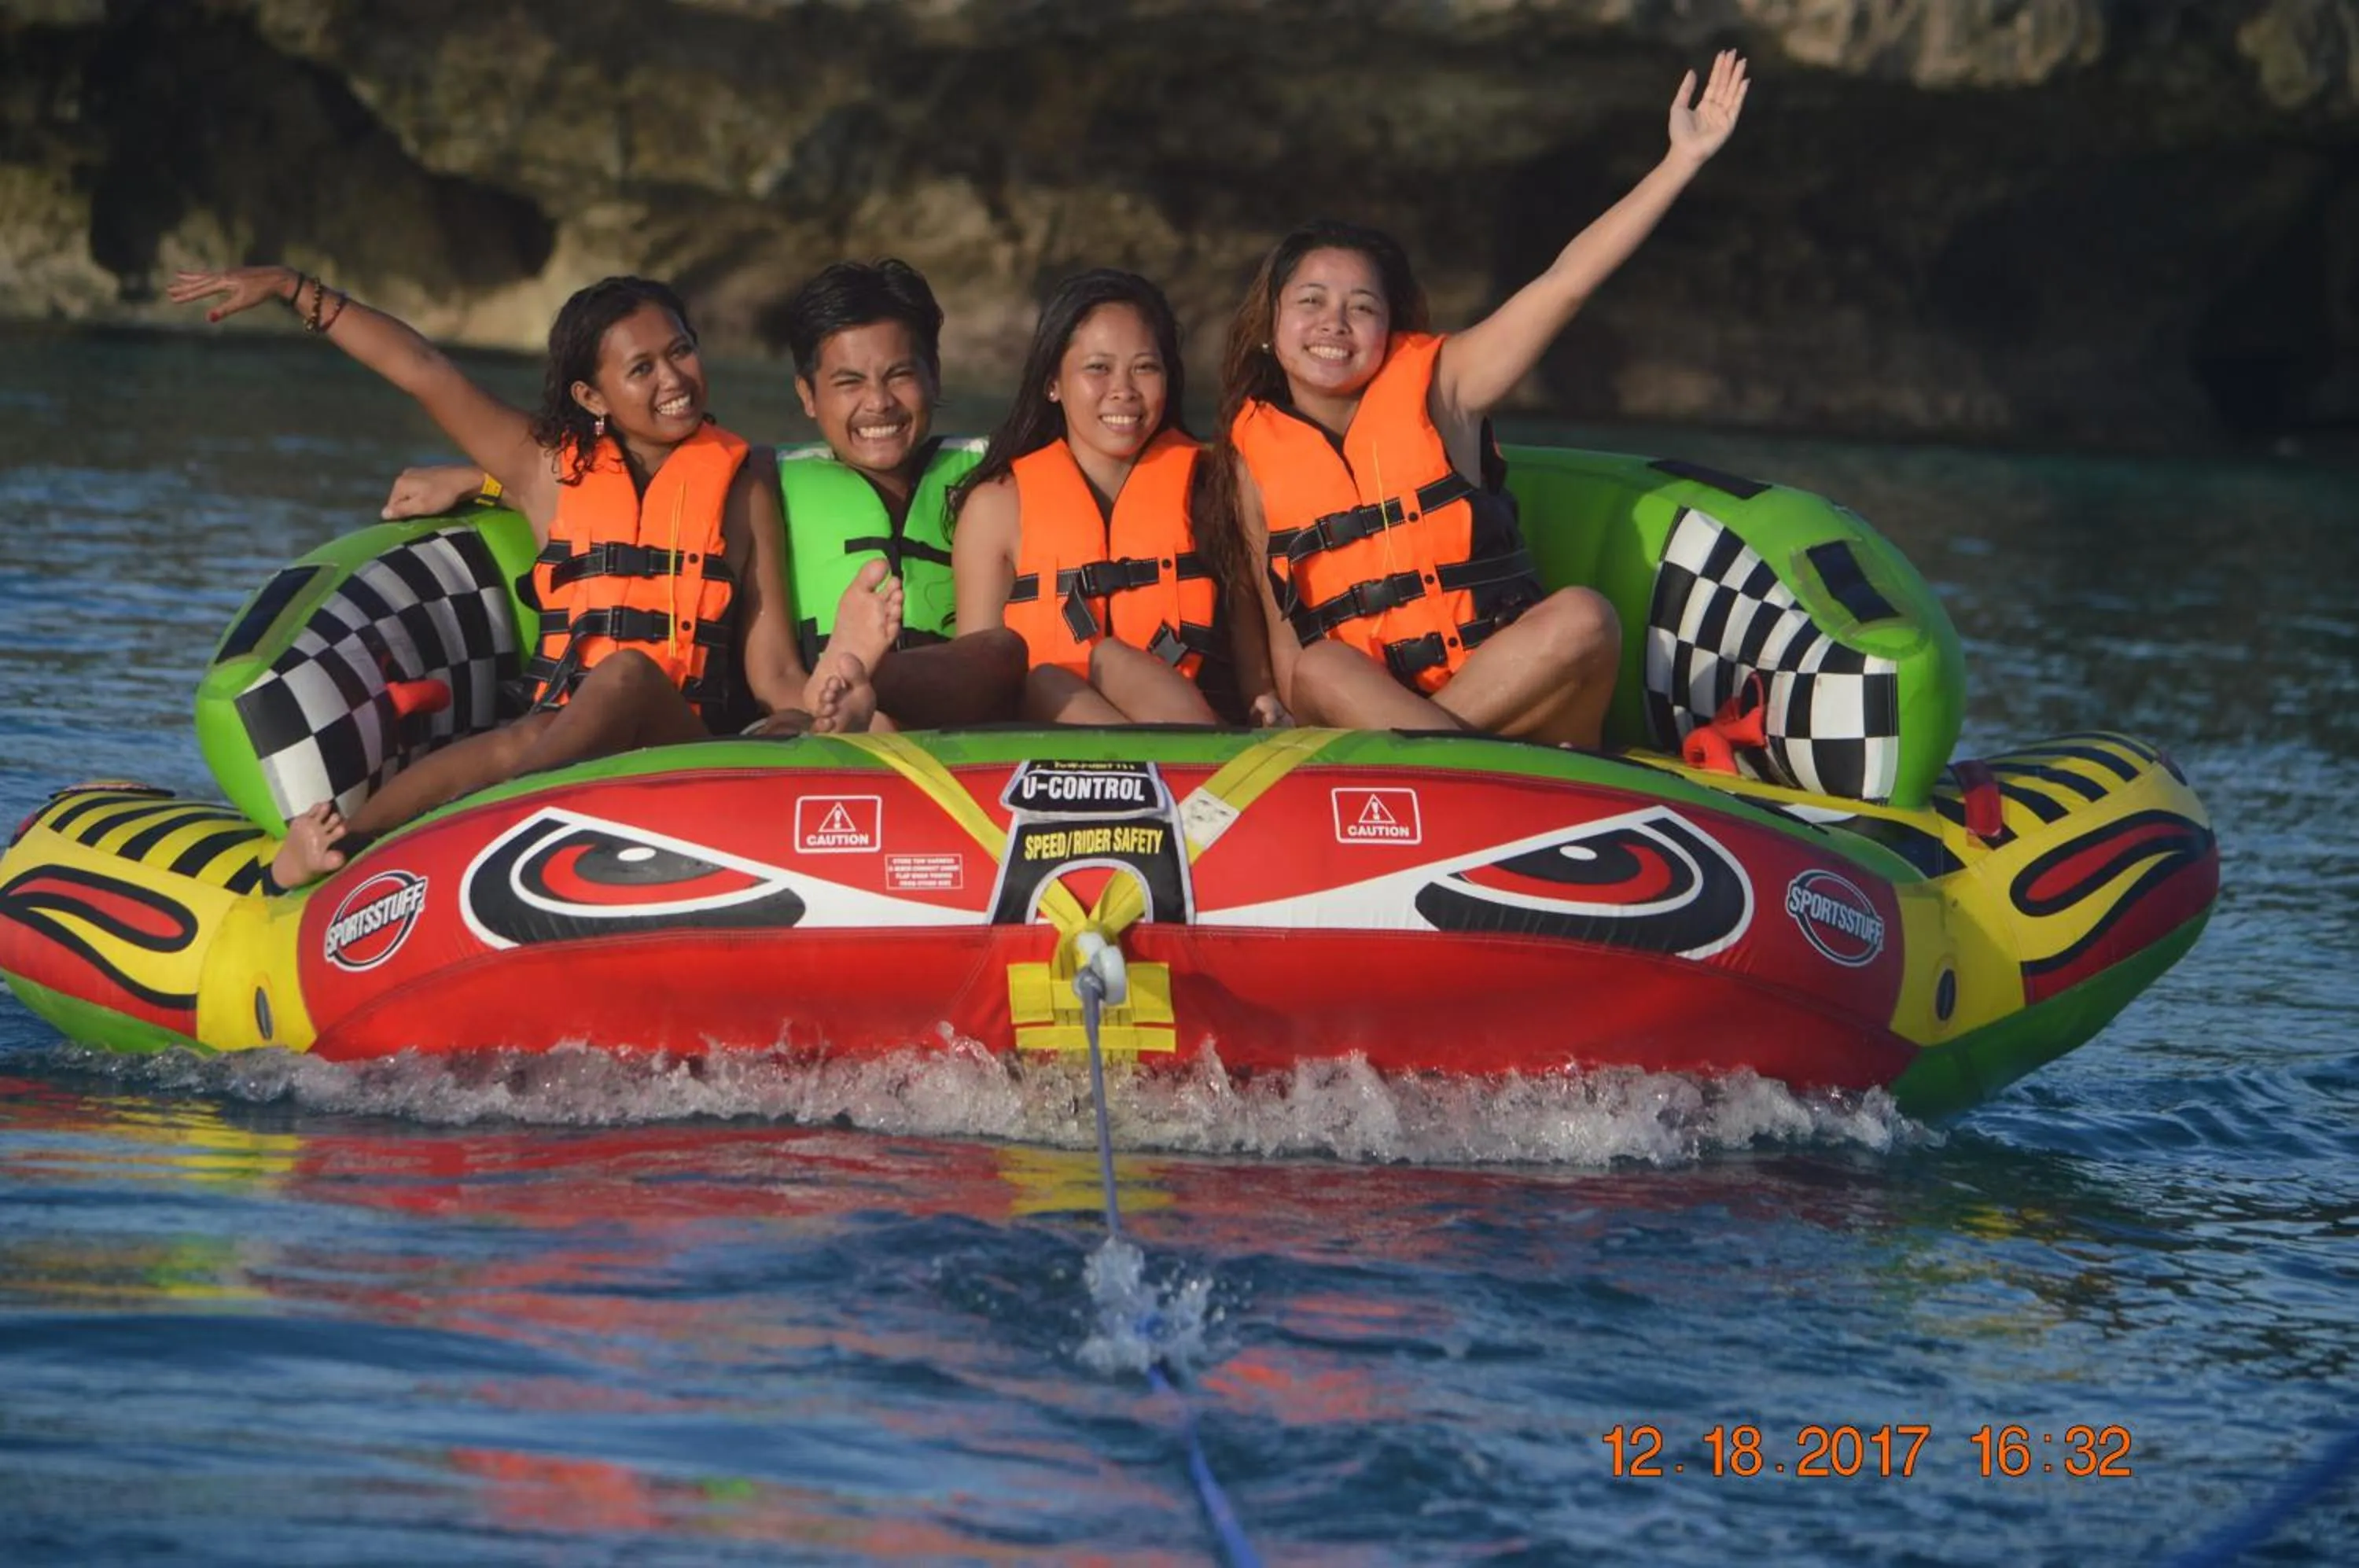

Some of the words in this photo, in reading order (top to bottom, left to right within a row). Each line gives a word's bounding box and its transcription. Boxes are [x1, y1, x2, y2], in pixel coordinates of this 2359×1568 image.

[1023, 776, 1145, 801] U-CONTROL
[806, 834, 869, 846] CAUTION
[1113, 827, 1162, 854] SAFETY
[1347, 825, 1410, 837] CAUTION
[327, 882, 424, 955] SPORTSSTUFF
[1789, 886, 1882, 945] SPORTSSTUFF
